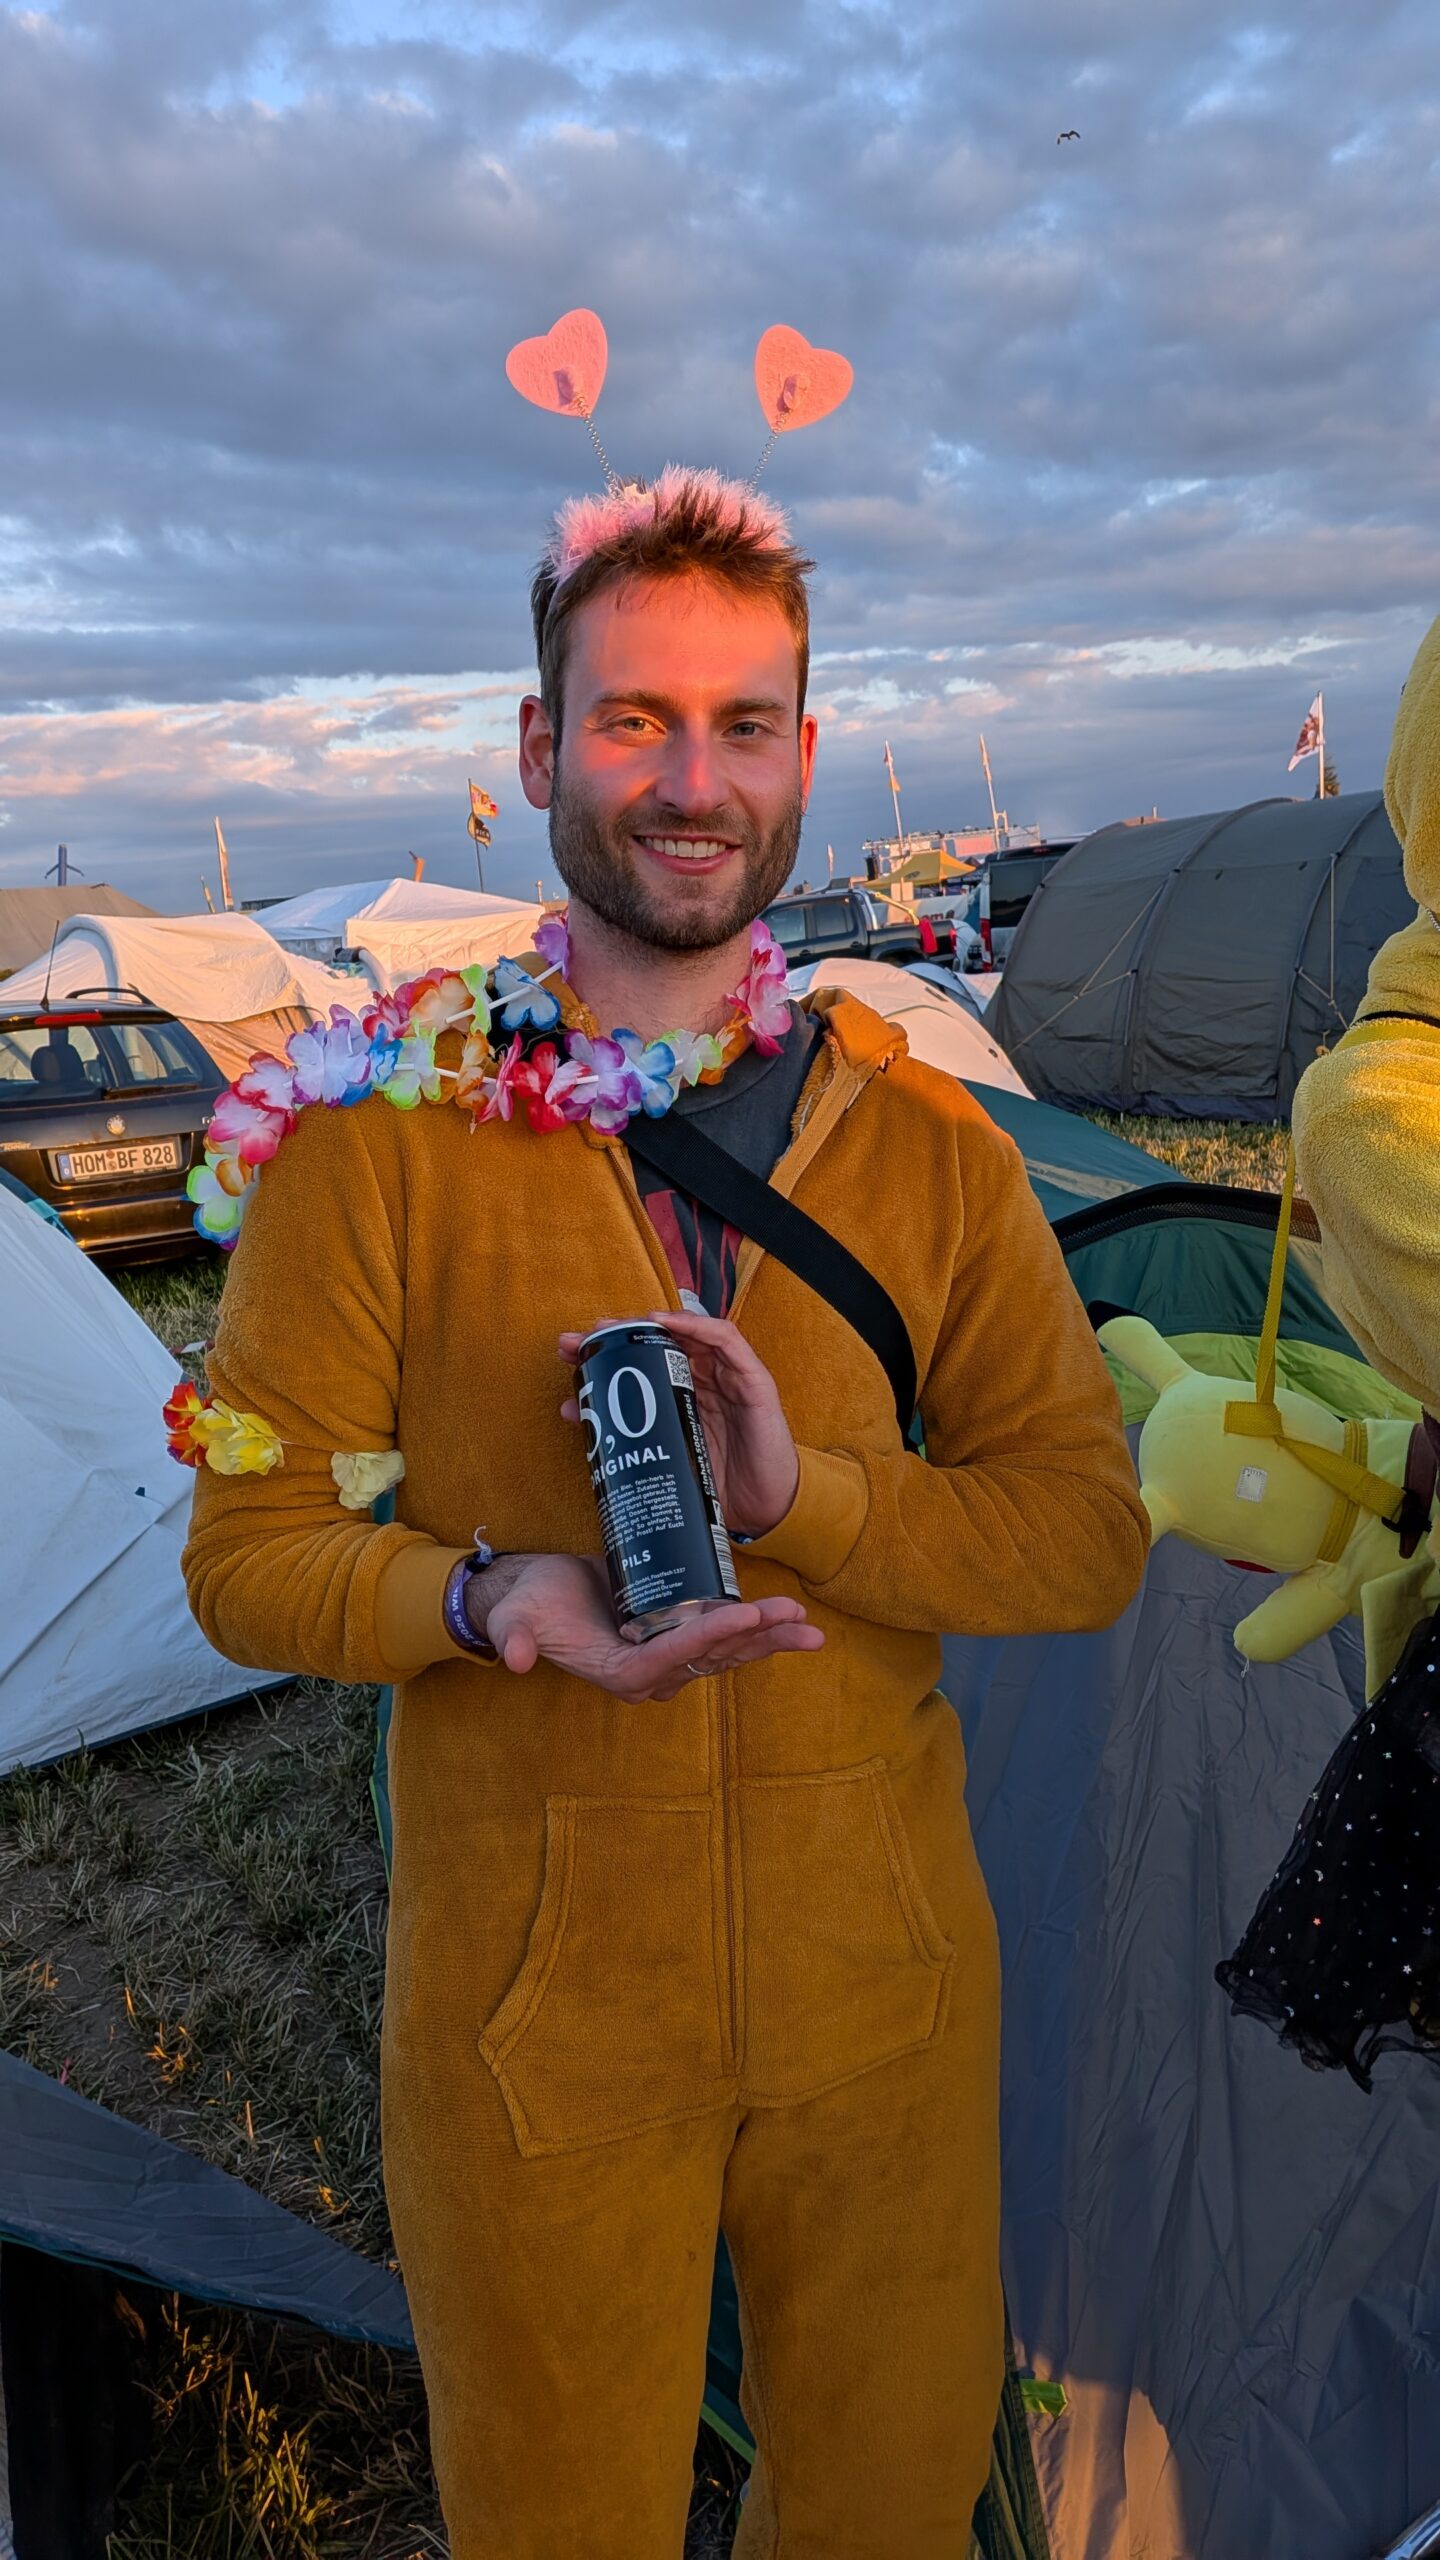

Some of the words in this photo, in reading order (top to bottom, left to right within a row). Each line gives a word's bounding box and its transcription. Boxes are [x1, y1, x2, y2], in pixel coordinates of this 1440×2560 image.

[72, 1153, 107, 1175] HOM
[117, 1150, 138, 1169] BF
[143, 1145, 174, 1166] 828
[579, 1366, 657, 1462] 5,0
[697, 1455, 709, 1486] Inhalt
[635, 1474, 664, 1486] fein-herb
[636, 1483, 660, 1493] Zutaten
[626, 1502, 642, 1511] Durst
[629, 1508, 648, 1517] Dosen
[630, 1517, 640, 1526] gut
[651, 1508, 673, 1517] kommt
[647, 1516, 672, 1526] einfach.
[656, 1523, 666, 1532] Auf
[668, 1520, 684, 1528] Euch!
[622, 1549, 651, 1572] PILS
